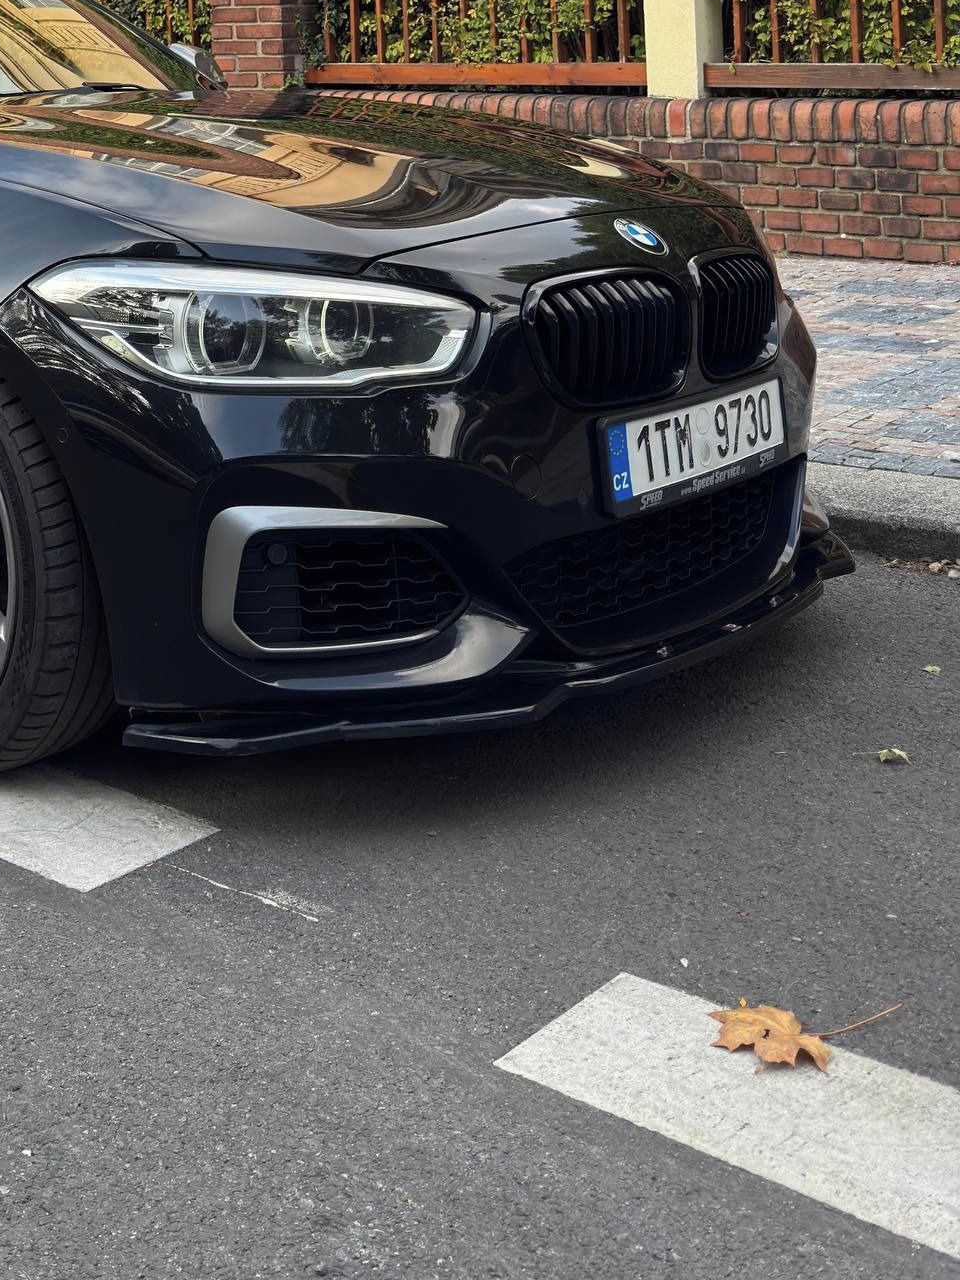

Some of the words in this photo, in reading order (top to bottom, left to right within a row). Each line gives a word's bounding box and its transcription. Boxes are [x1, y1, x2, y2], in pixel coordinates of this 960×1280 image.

[637, 413, 695, 482] 1TM
[714, 389, 772, 458] 9730
[613, 472, 629, 491] CZ
